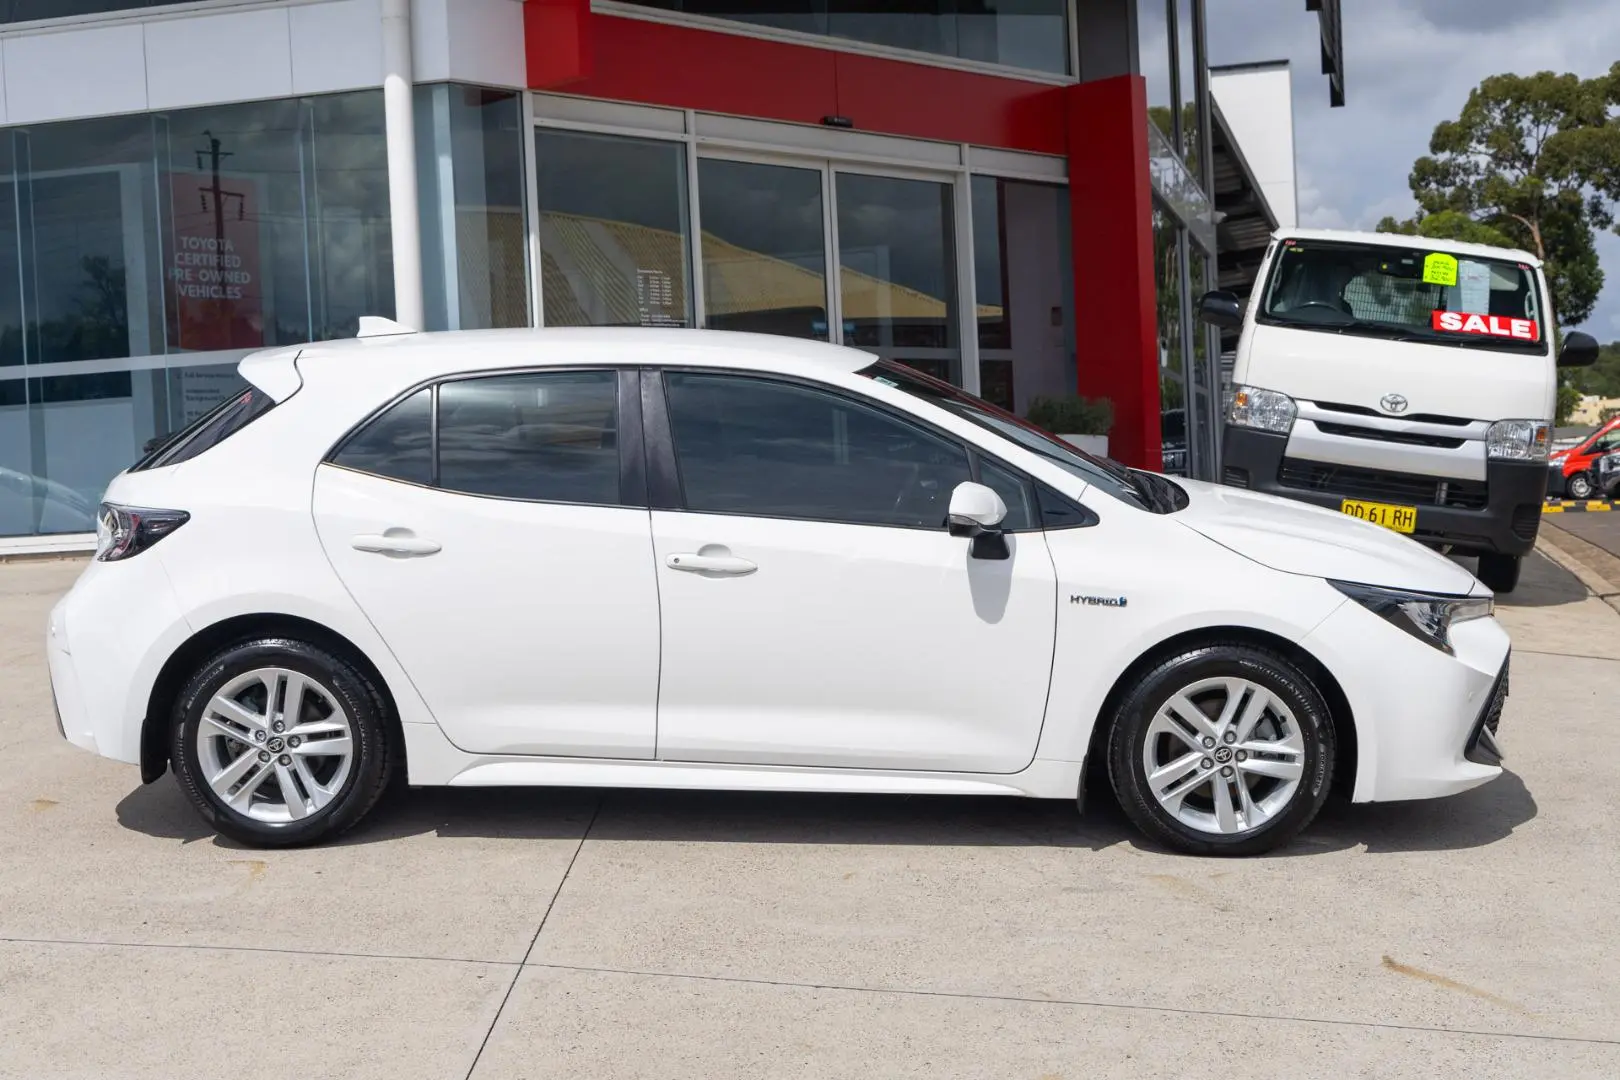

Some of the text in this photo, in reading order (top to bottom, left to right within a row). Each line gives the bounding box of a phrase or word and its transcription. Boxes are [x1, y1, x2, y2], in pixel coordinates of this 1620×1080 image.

[181, 237, 234, 252] TOYOTA
[175, 252, 242, 269] CERTIFIED
[178, 284, 243, 300] VEHICLES
[1440, 312, 1532, 339] SALE
[1070, 594, 1118, 607] HYBRID
